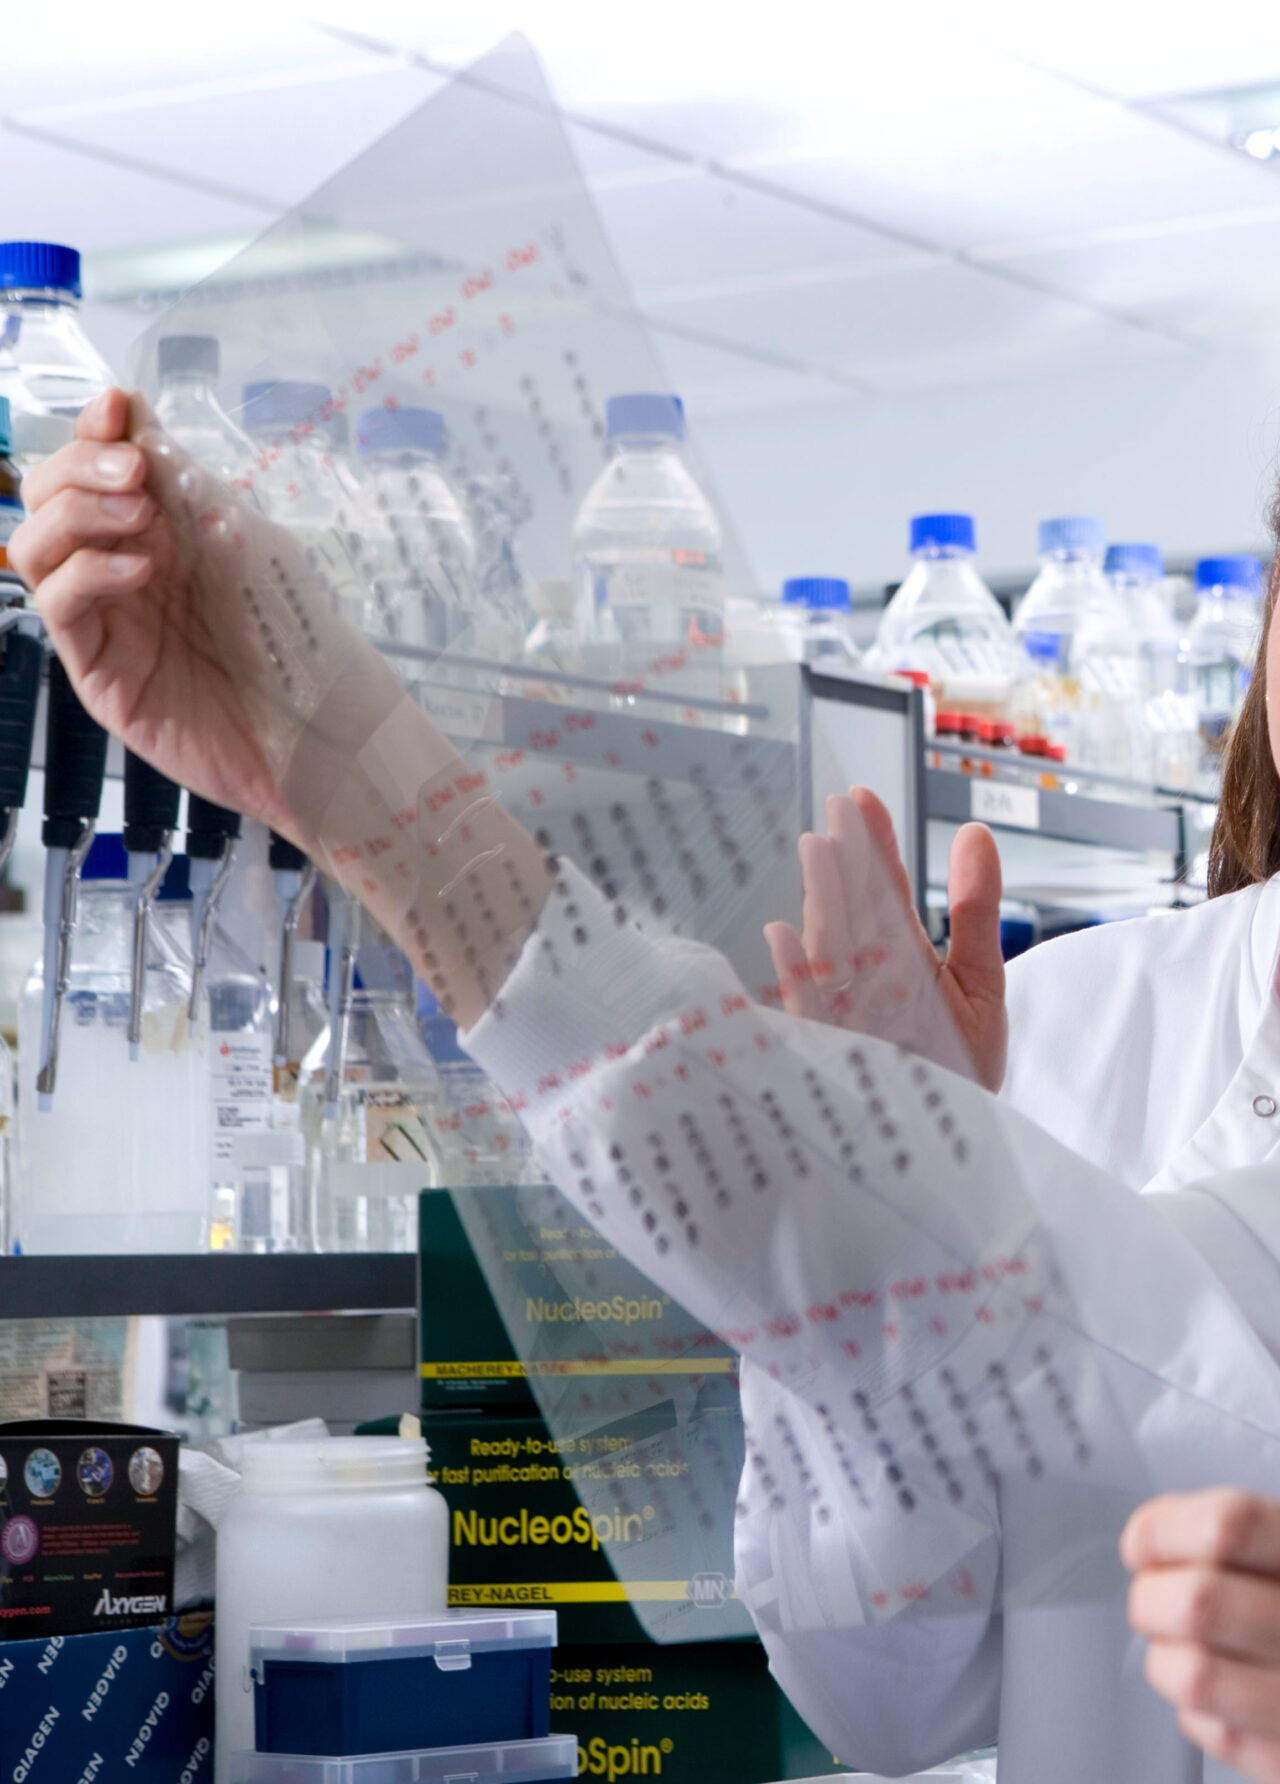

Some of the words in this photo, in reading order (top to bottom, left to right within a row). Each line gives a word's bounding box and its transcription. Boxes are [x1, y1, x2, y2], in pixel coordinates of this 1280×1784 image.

[470, 1436, 580, 1458] Ready-to-use
[442, 1466, 470, 1483] fast
[472, 1463, 559, 1486] purification
[453, 1504, 655, 1551] NucleoSpin®
[82, 1645, 128, 1722] QIAGEN
[596, 1665, 652, 1686] system
[579, 1692, 596, 1709] of
[598, 1692, 660, 1709] nucleic
[663, 1692, 710, 1709] acids
[12, 1705, 61, 1784] QIAGEN
[125, 1691, 170, 1768] QIAGEN
